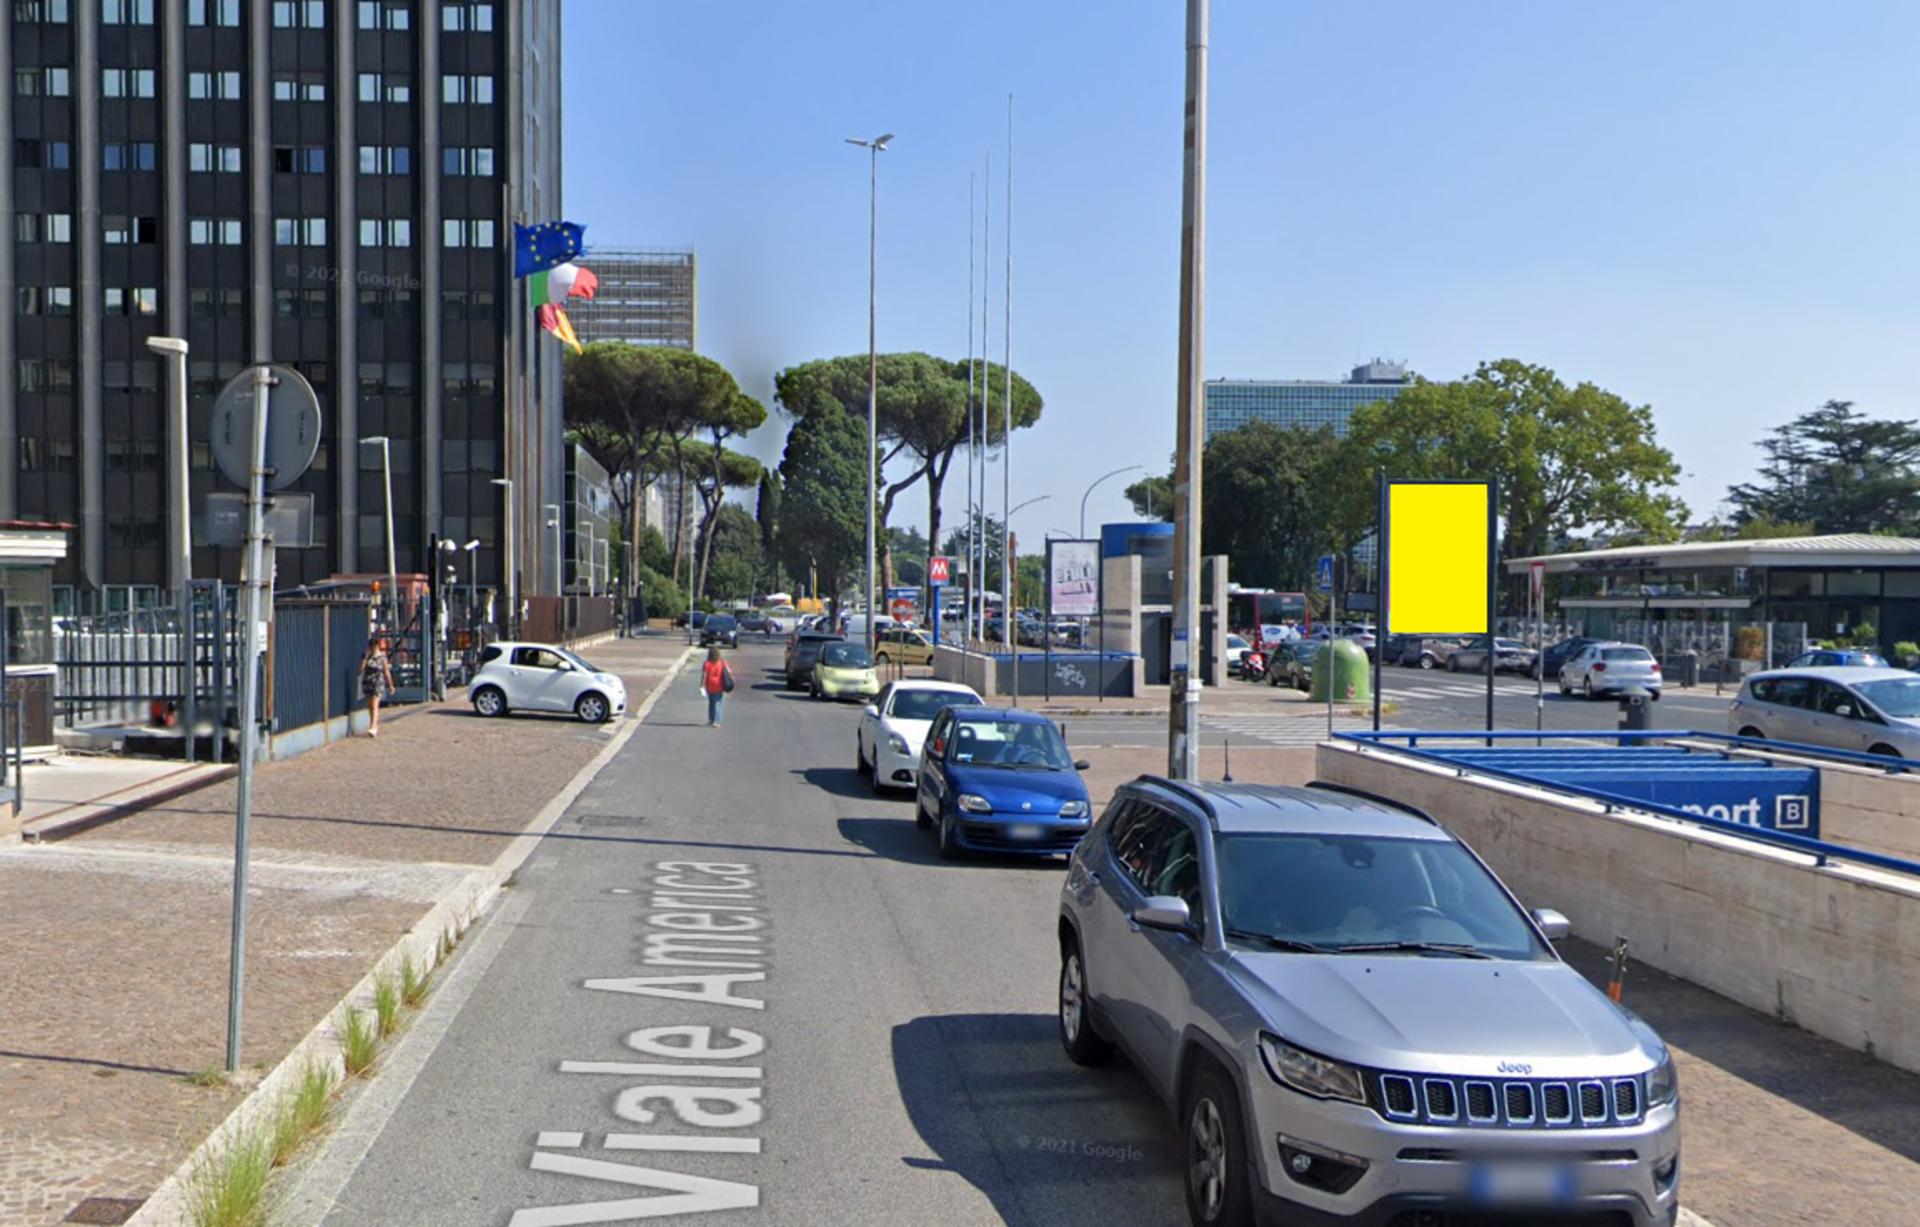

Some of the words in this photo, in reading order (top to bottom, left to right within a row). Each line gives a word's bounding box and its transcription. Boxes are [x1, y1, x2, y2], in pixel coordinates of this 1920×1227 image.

[931, 561, 948, 577] M
[1786, 802, 1800, 820] B
[1496, 1060, 1533, 1075] Jeep
